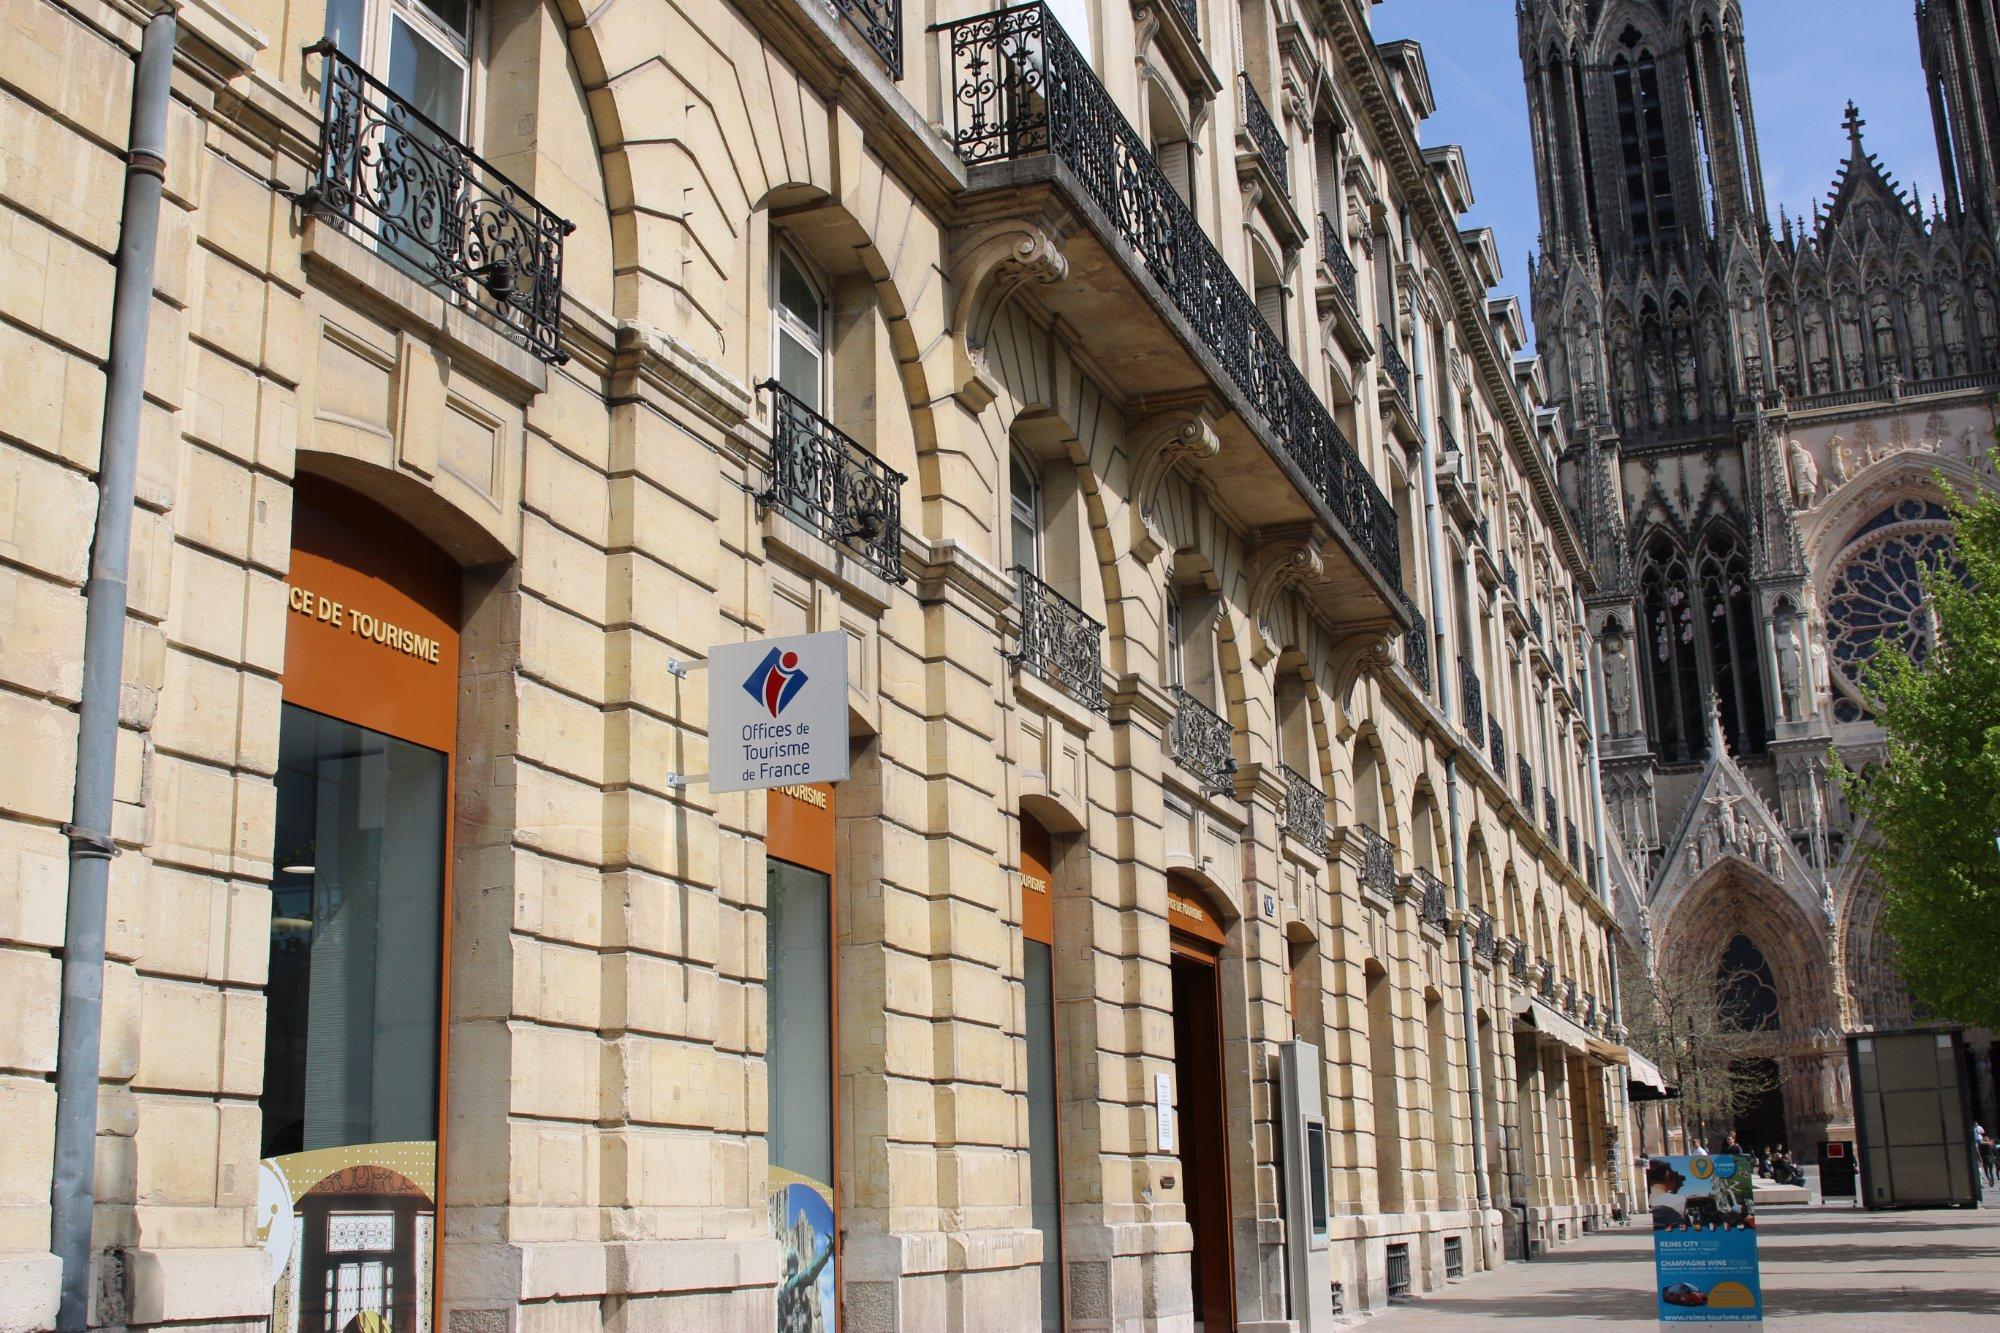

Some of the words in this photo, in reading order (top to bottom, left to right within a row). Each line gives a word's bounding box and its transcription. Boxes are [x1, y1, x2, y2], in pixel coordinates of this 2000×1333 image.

[318, 596, 343, 626] DE
[349, 608, 440, 663] TOURISME
[742, 723, 792, 741] Offices
[796, 722, 810, 735] de
[742, 742, 810, 761] Tourisme
[742, 769, 756, 781] de
[760, 762, 810, 779] France
[1664, 1313, 1757, 1321] www.reims-tourisme.com
